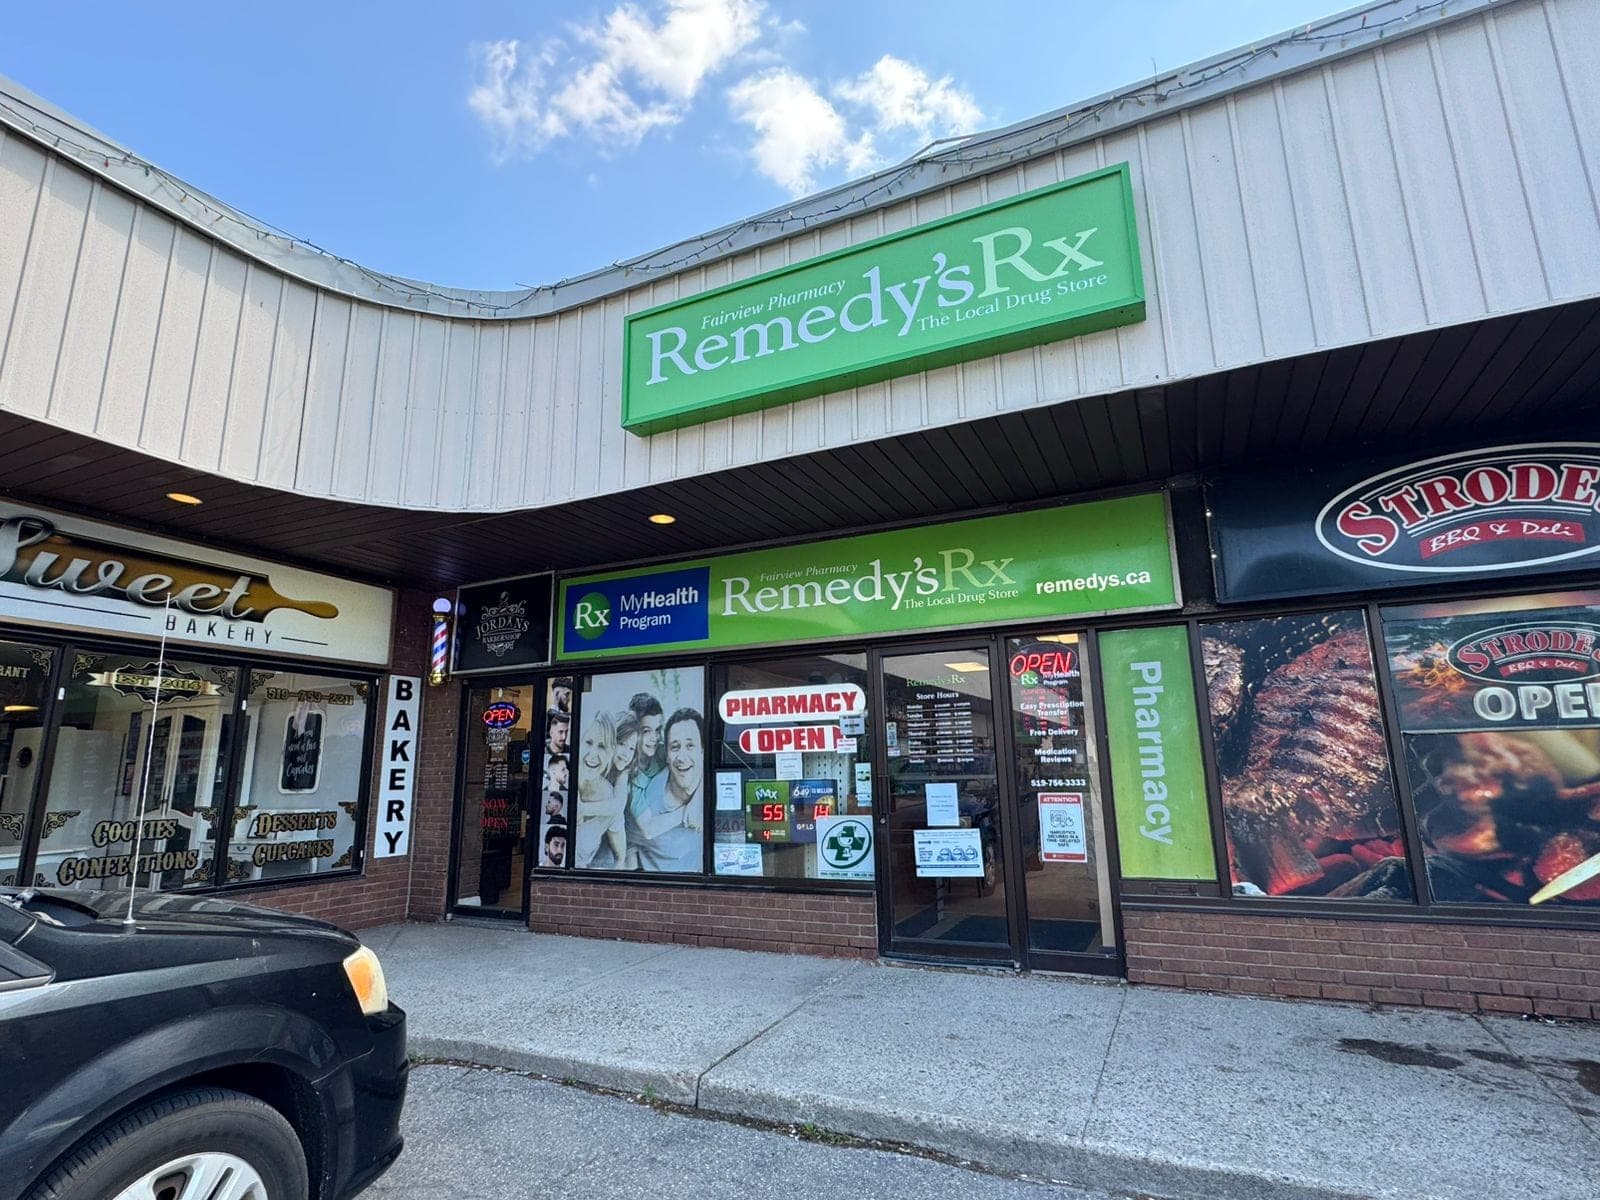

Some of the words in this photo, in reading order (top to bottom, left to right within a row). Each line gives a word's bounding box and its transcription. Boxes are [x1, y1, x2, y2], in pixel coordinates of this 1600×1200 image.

[700, 303, 764, 331] Fairview
[767, 277, 846, 313] Pharmacy
[917, 312, 950, 332] The
[955, 301, 1000, 324] Local
[1006, 286, 1052, 310] Drug
[1056, 273, 1108, 295] Store
[1337, 463, 1600, 556] STRODE
[1428, 526, 1481, 553] BBQ
[1521, 521, 1576, 537] Deli
[759, 569, 803, 582] Fairview
[805, 562, 858, 580] Pharmacy
[1035, 568, 1152, 596] remedys.ca
[574, 602, 611, 630] Rx
[620, 586, 699, 614] MyHealth
[904, 597, 924, 610] The
[926, 593, 955, 608] Local
[957, 591, 987, 606] Drug
[988, 587, 1019, 600] Store
[165, 614, 273, 645] BAKERY
[620, 614, 672, 630] Program
[1010, 652, 1072, 676] OPEN
[1554, 659, 1581, 669] Deli
[116, 673, 154, 686] EST
[1021, 673, 1039, 685] Rx
[726, 691, 858, 717] PHARMACY
[916, 692, 936, 700] Store
[936, 691, 960, 699] Hours
[1020, 702, 1038, 711] Easy
[483, 708, 516, 723] OPEN
[1037, 708, 1068, 716] Transfer
[757, 727, 826, 752] OPEN
[1029, 729, 1047, 737] Free
[1048, 728, 1079, 737] Delivery
[1034, 747, 1077, 756] Medication
[1040, 755, 1072, 763] Reviews
[1130, 661, 1174, 846] Pharmacy
[384, 679, 413, 854] BAKERY
[763, 804, 784, 820] 55
[91, 819, 178, 848] COOKIES
[255, 811, 338, 838] DESSERTS
[253, 838, 335, 867] CUPCAKES
[56, 849, 199, 886] CONFECTIONS
